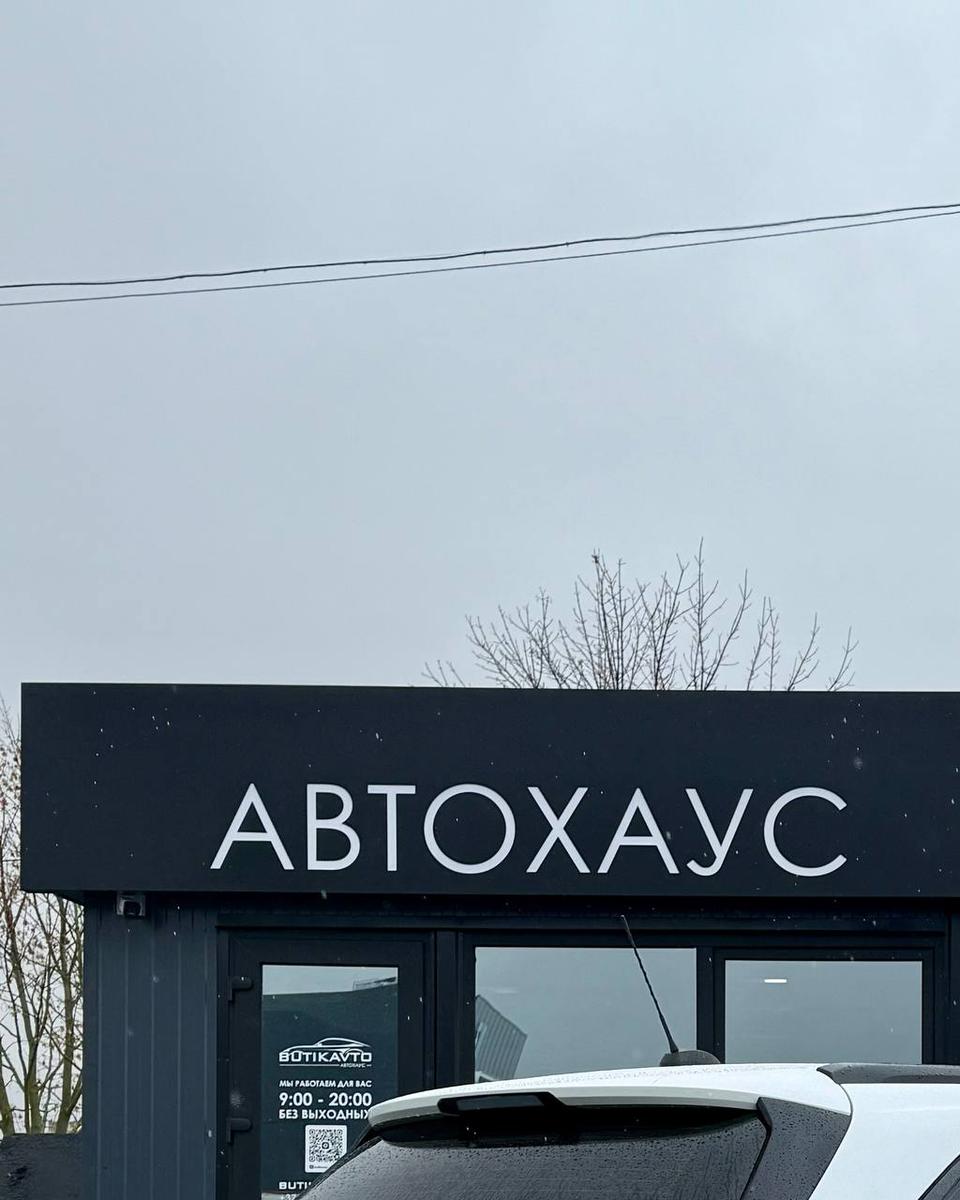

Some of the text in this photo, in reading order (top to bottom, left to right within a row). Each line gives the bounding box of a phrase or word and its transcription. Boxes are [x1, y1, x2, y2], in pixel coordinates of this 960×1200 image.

[211, 783, 848, 877] АВТОХАУС
[279, 1051, 372, 1062] BUTIKAVTO
[337, 1080, 354, 1088] ДЛЯ
[279, 1092, 313, 1106] 9:00
[329, 1092, 372, 1106] 20:00
[279, 1109, 298, 1119] БЕЗ
[279, 1181, 312, 1190] BUTI
